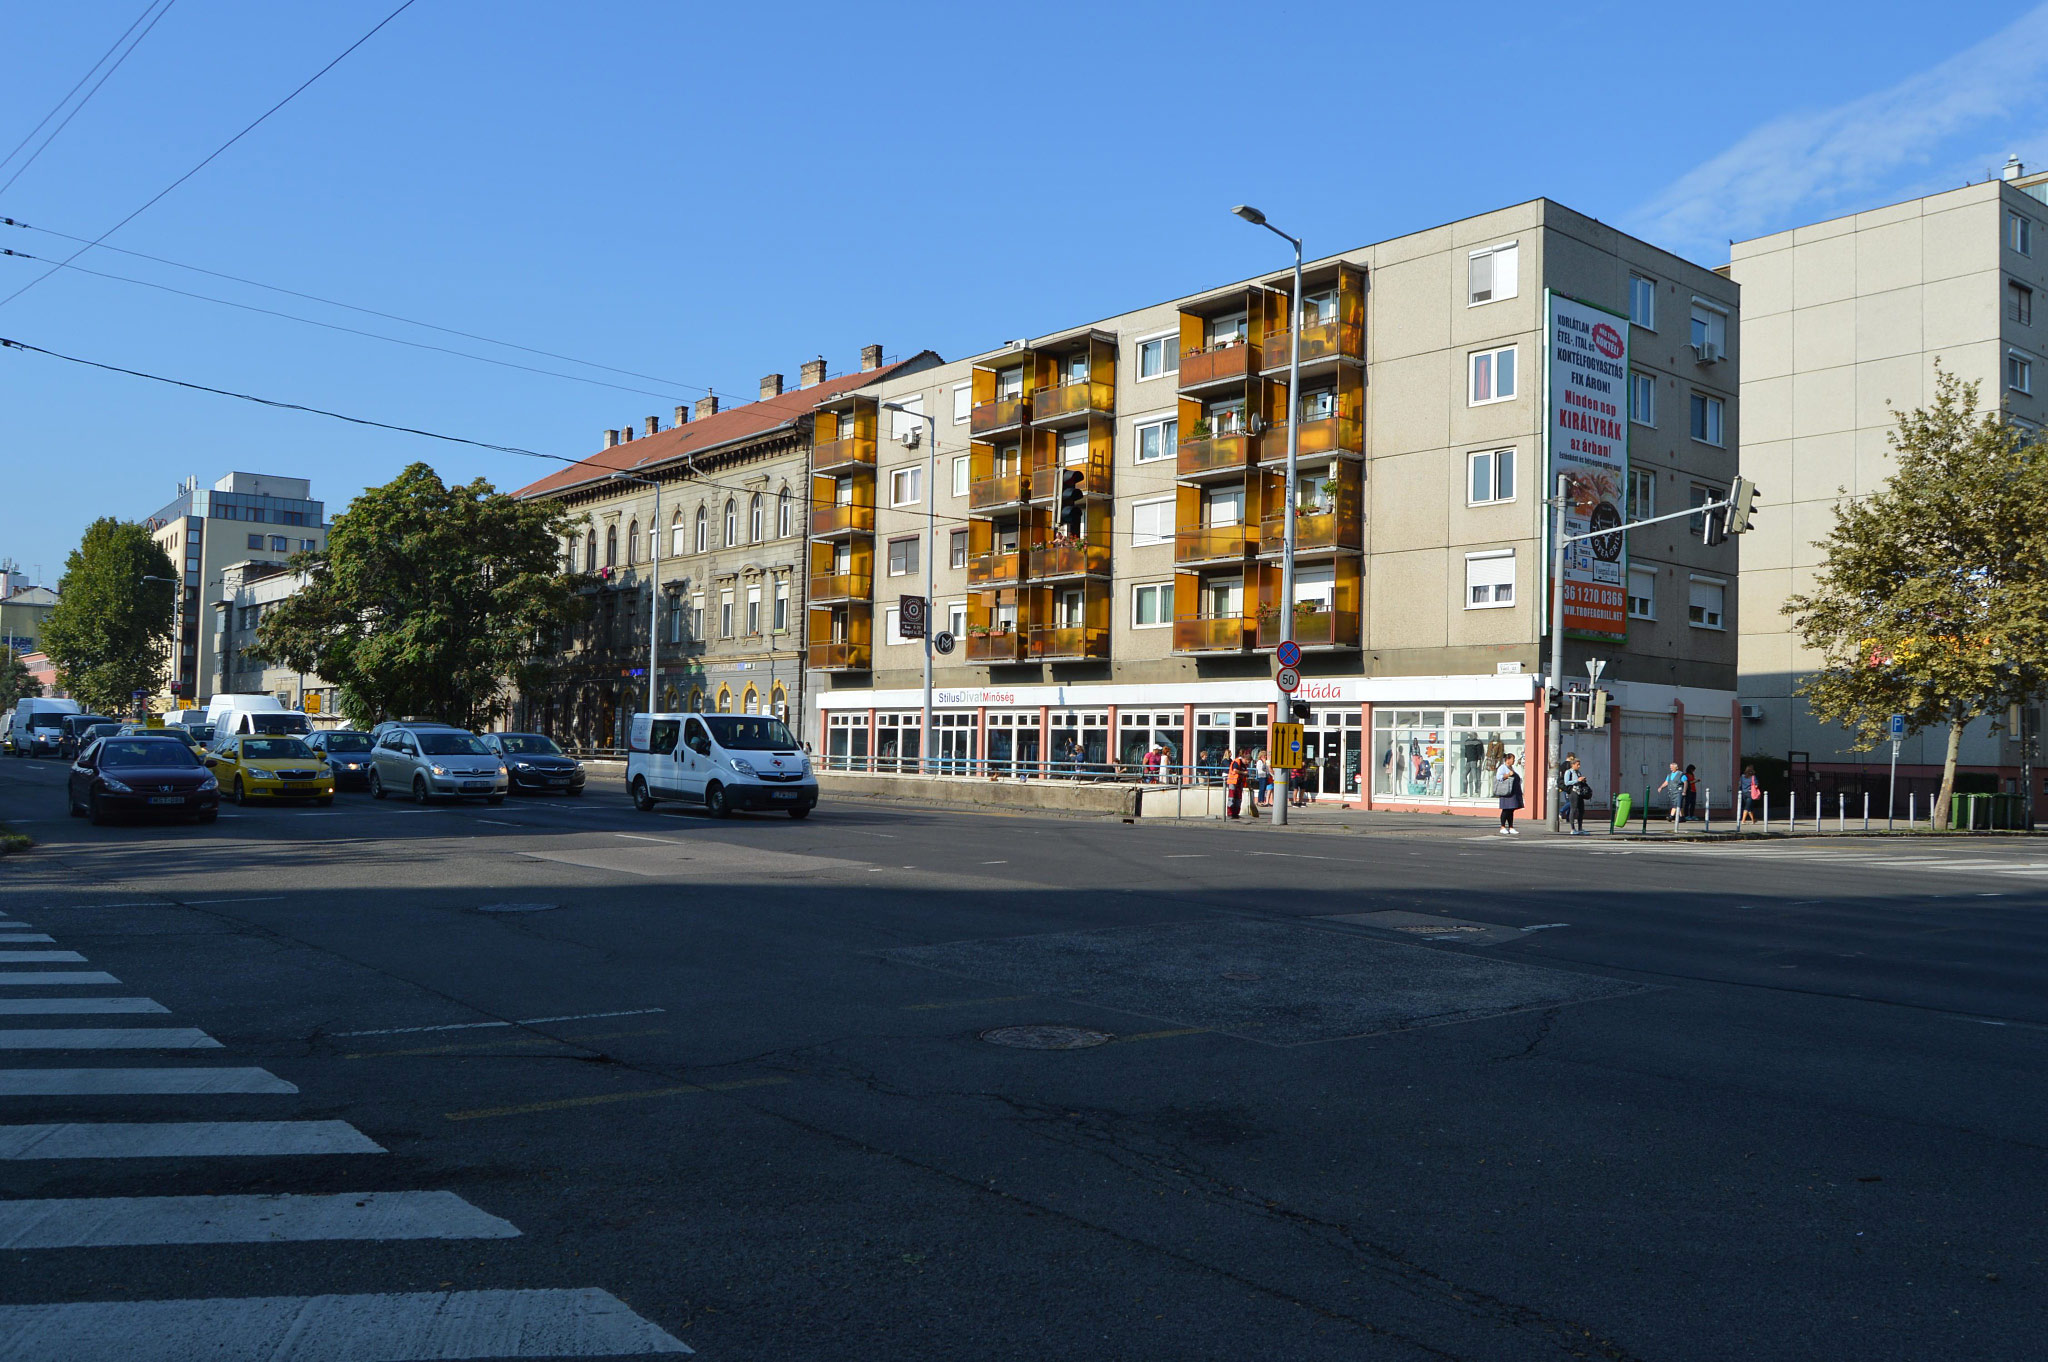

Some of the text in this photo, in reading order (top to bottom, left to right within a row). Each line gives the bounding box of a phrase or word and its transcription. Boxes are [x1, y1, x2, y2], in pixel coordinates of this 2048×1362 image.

[1558, 314, 1590, 333] KORLÁTLAN
[1575, 336, 1587, 350] ITAL
[1589, 342, 1595, 352] és
[1557, 348, 1623, 379] KOKTÉLFOGYASZTÁS
[1571, 372, 1611, 394] FIX ÁRON!
[1565, 390, 1616, 416] Minden nap
[1560, 409, 1622, 440] KIRÁLYRÁK
[1571, 437, 1611, 458] az árban!
[1578, 587, 1582, 601] 1
[1584, 588, 1599, 603] 270
[1602, 590, 1623, 606] 0366
[1282, 674, 1294, 685] 50
[1300, 683, 1341, 698] Háda
[1894, 717, 1902, 731] P
